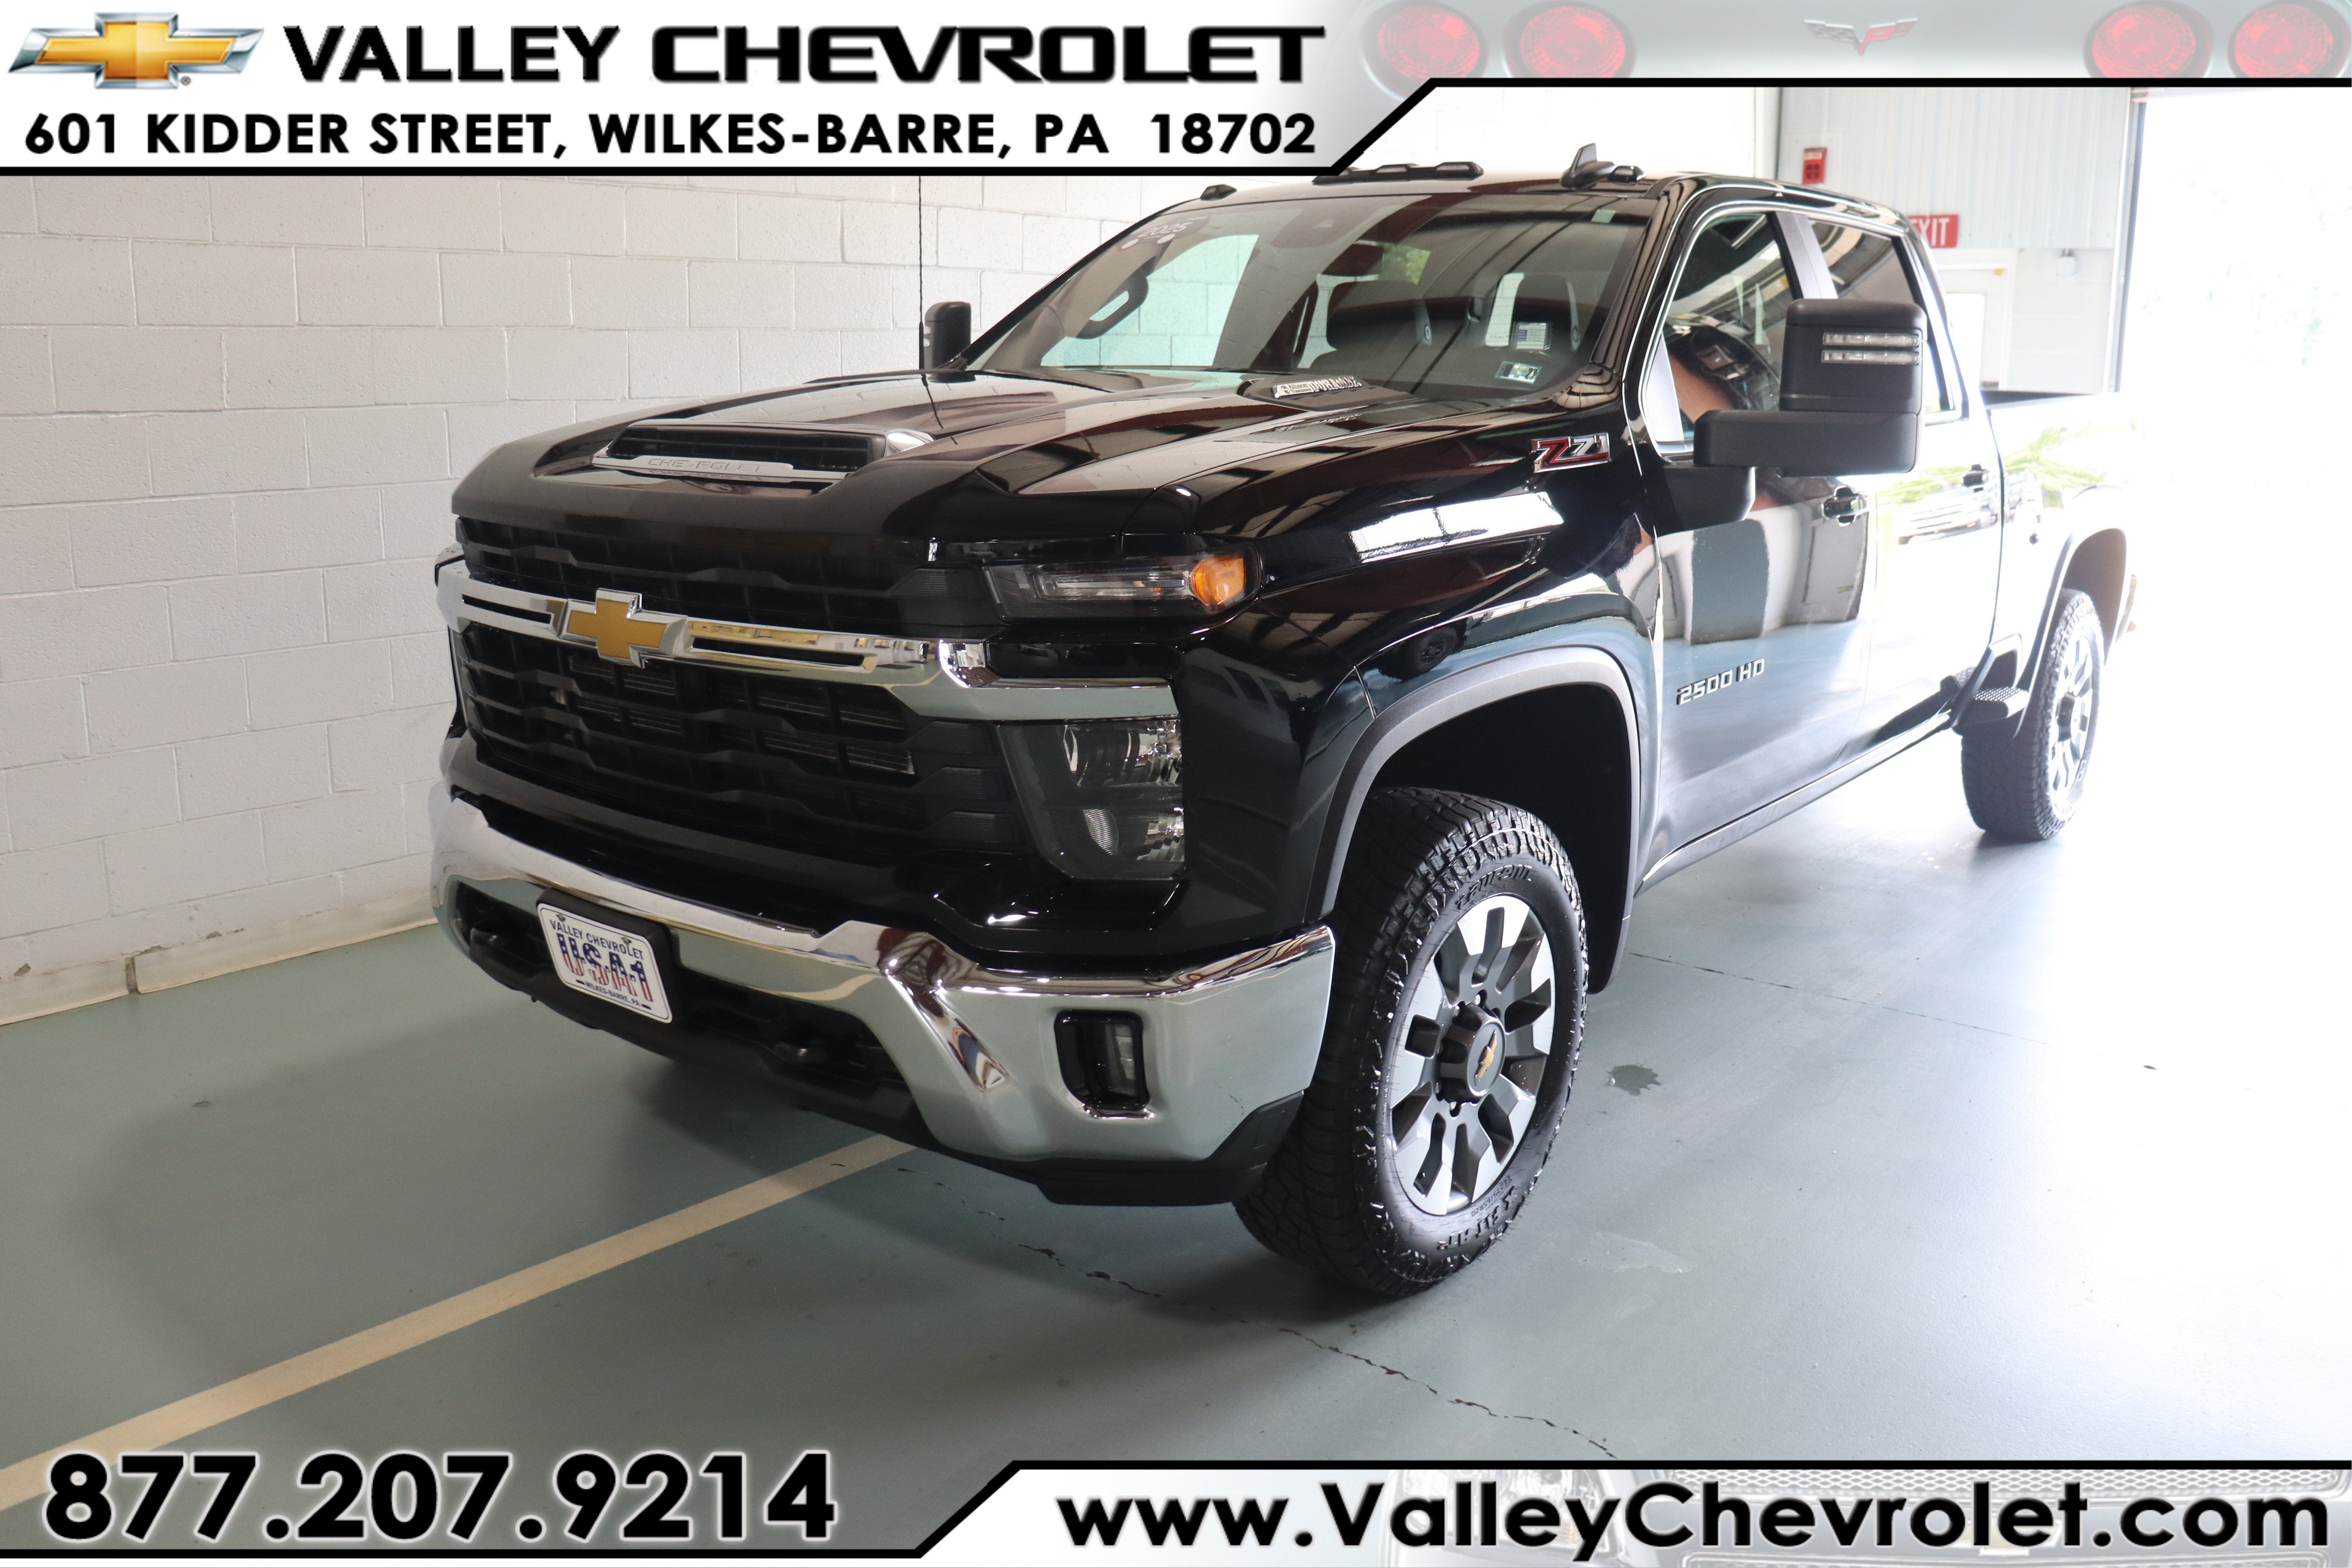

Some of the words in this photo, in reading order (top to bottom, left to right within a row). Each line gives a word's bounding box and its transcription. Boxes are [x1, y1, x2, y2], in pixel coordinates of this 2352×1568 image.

[1138, 222, 1193, 238] 2025
[1911, 218, 1950, 246] XIT
[1530, 433, 1610, 474] Z71
[1676, 669, 1733, 706] 2500
[1735, 657, 1765, 682] HD
[549, 919, 584, 940] VALLEY
[586, 932, 643, 960] CHEVROLET
